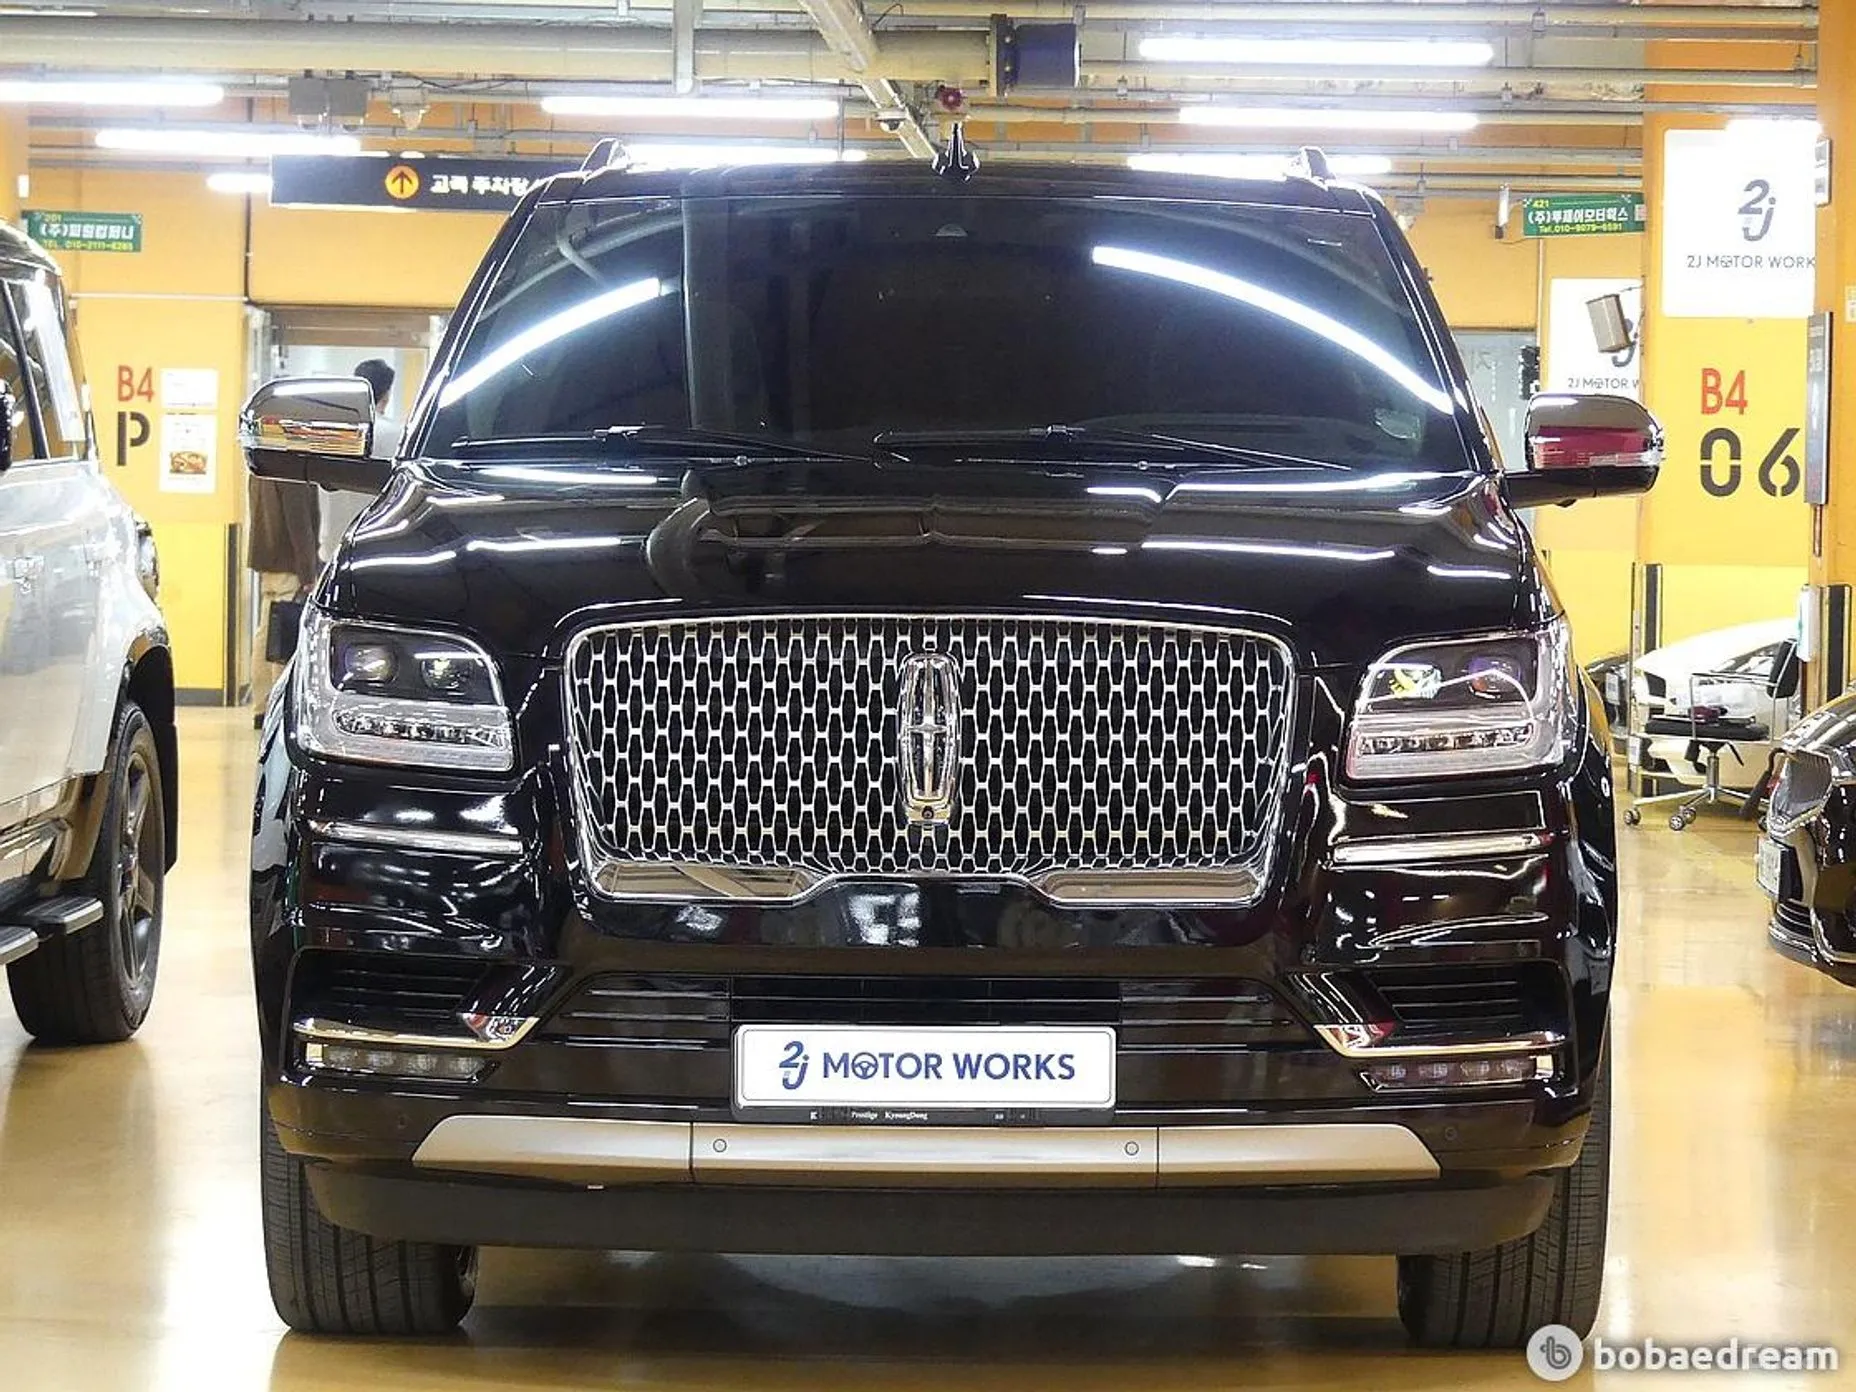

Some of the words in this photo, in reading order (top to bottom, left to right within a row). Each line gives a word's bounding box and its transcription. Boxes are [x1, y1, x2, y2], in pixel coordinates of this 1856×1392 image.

[1687, 255, 1702, 268] 2J
[1706, 255, 1763, 268] MOTOR
[117, 365, 153, 402] B4
[1701, 368, 1748, 415] B4
[117, 411, 150, 467] P
[1700, 427, 1801, 497] 06
[823, 1052, 943, 1080] MOTOR
[953, 1053, 1076, 1081] WORKS
